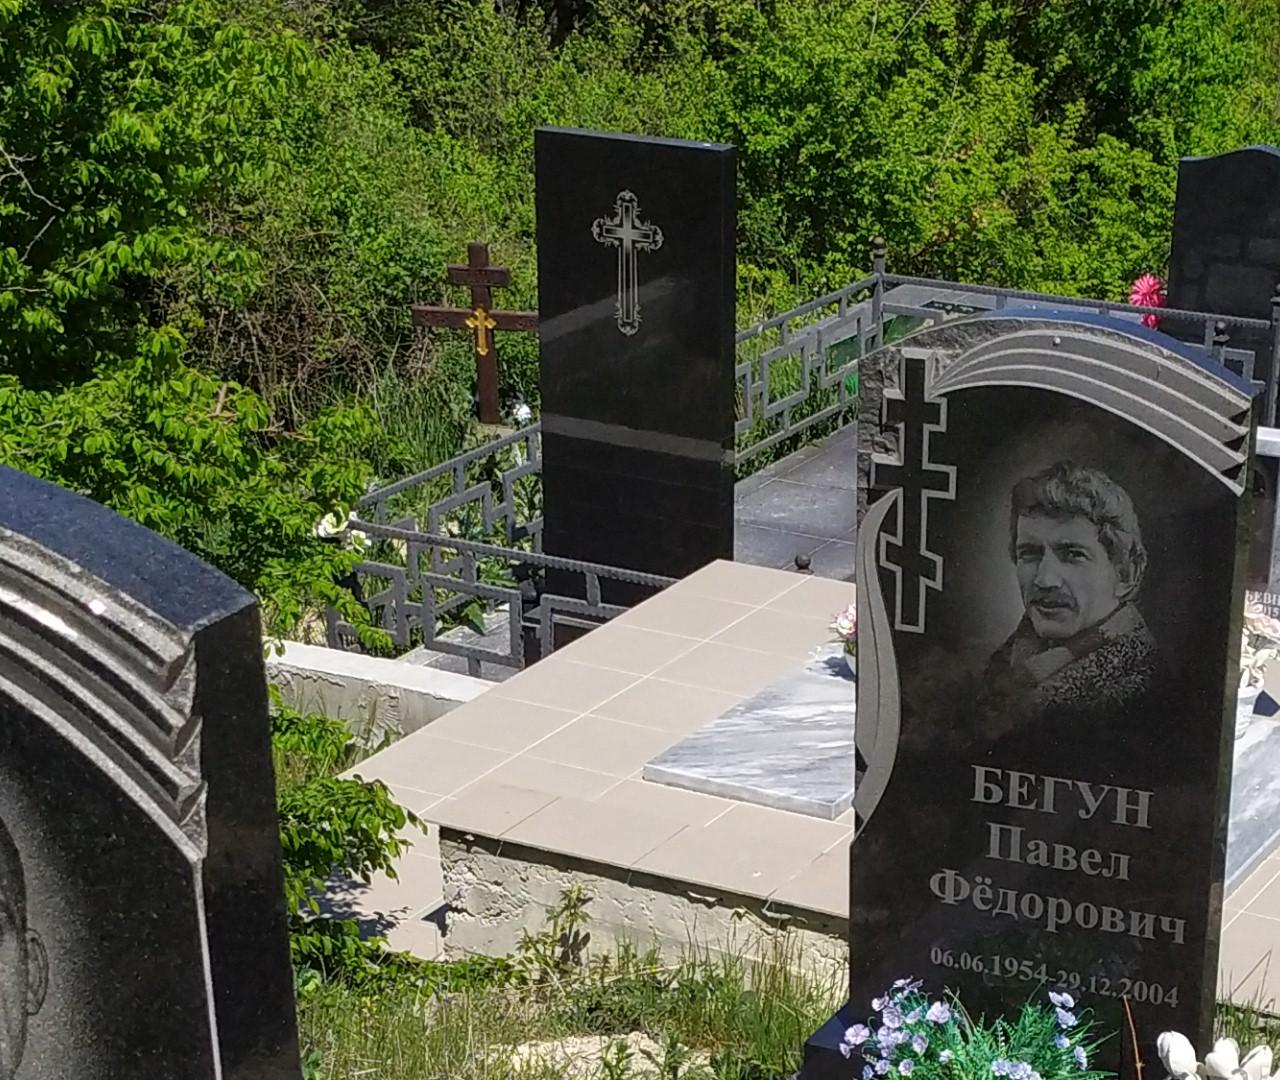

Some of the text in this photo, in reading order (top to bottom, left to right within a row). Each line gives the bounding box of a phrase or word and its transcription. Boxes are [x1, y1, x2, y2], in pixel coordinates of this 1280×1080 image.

[970, 764, 1155, 830] БЕГУН
[984, 821, 1131, 881] Павел
[929, 868, 1187, 945] Фёдорович
